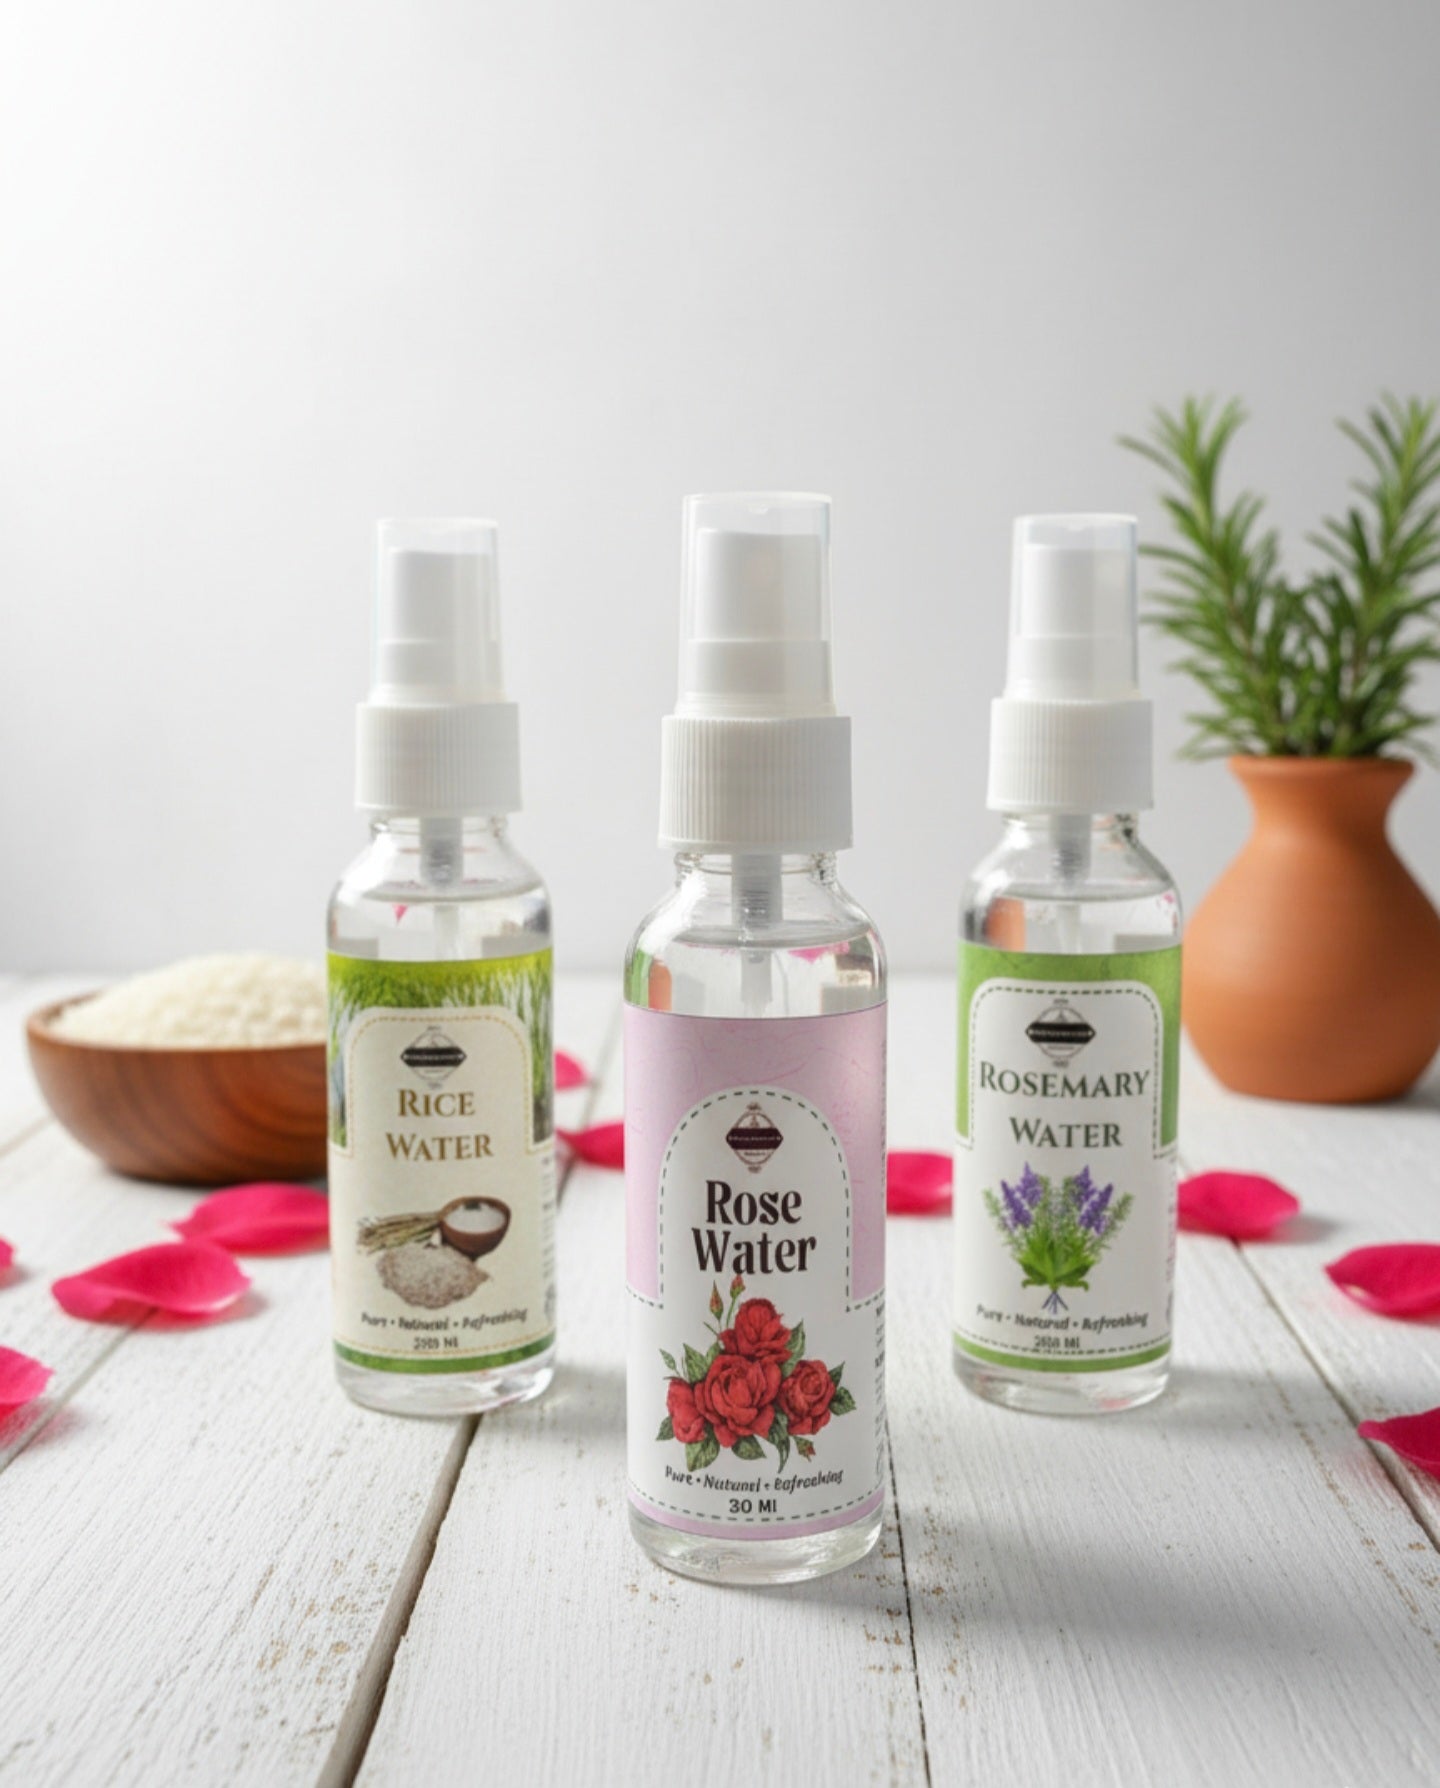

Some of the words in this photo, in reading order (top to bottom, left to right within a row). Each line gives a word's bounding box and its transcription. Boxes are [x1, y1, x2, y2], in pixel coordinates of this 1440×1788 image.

[980, 1061, 1150, 1098] ROSEMARY
[397, 1089, 476, 1117] RICE
[386, 1133, 494, 1161] WATER
[1009, 1117, 1123, 1148] WATER
[705, 1180, 803, 1226] Rose
[691, 1227, 818, 1275] Water
[729, 1499, 752, 1514] 30
